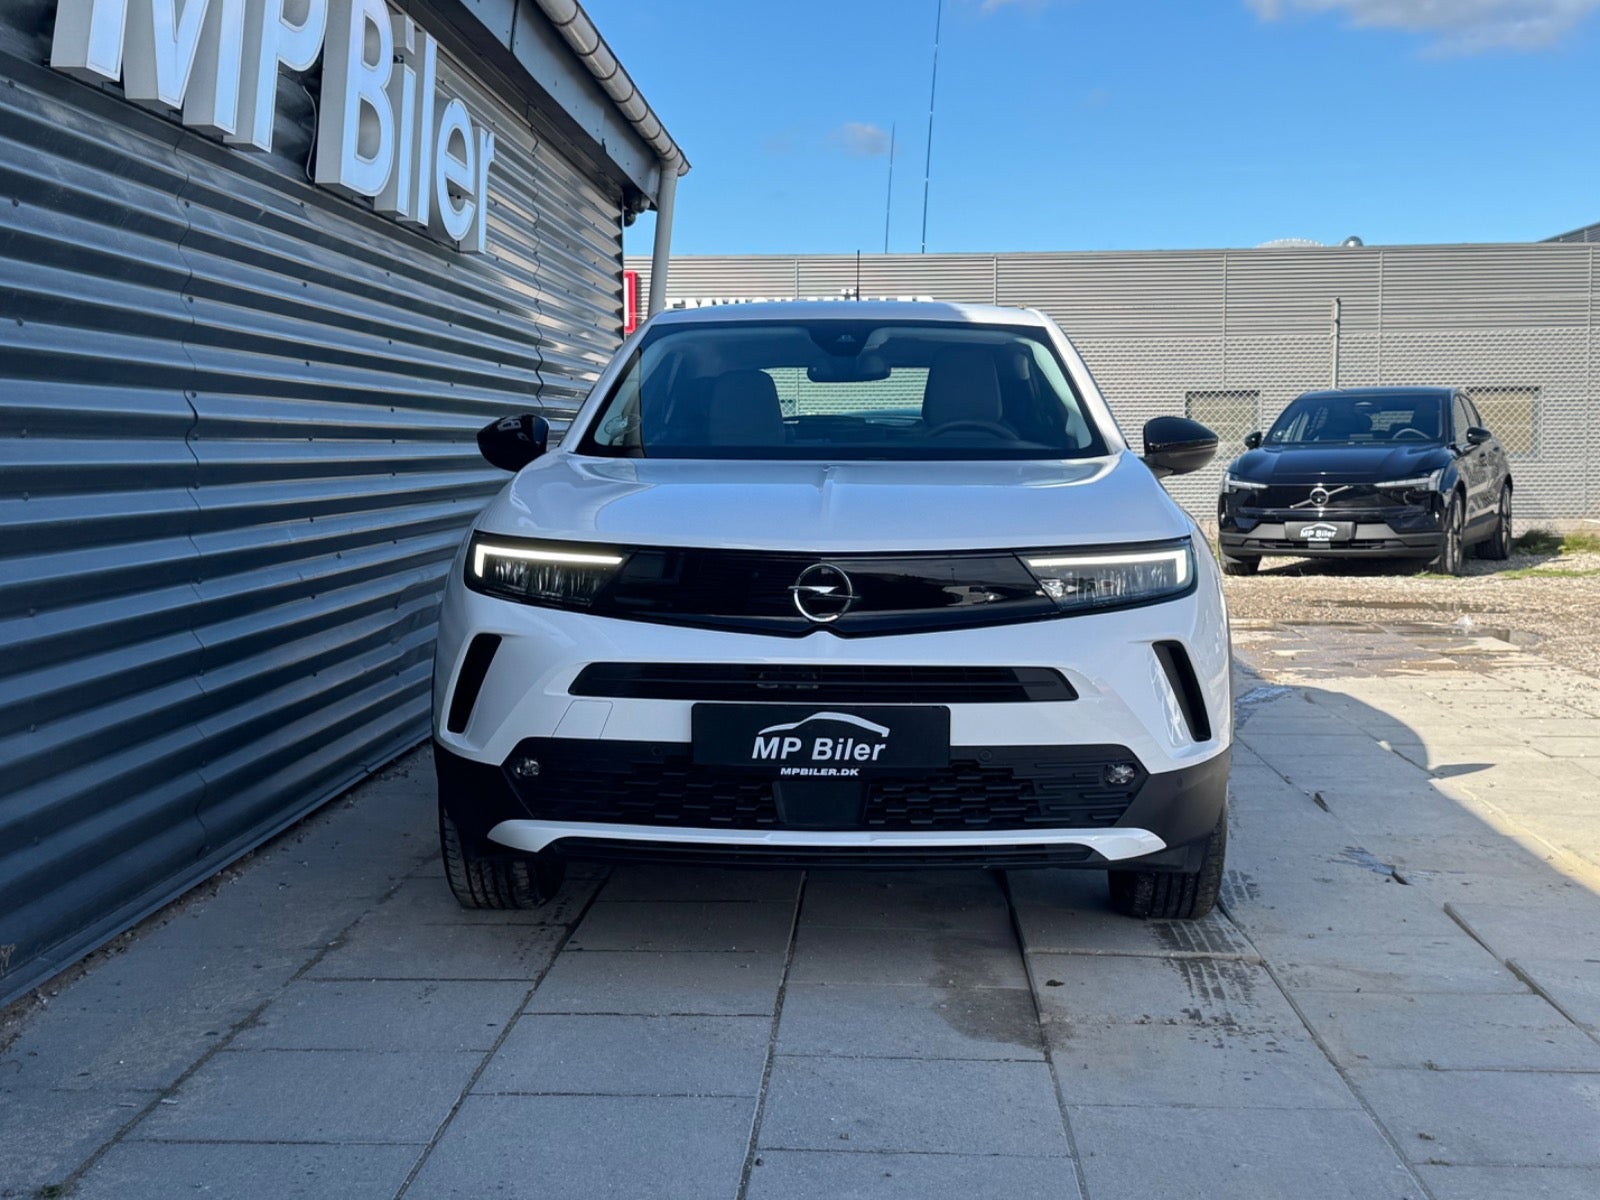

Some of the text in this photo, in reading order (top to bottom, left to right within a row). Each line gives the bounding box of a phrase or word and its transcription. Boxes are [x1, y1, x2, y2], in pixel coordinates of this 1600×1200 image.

[336, 0, 495, 254] Biler
[752, 736, 886, 761] MP Biler
[780, 767, 860, 776] MPBILER.DK
